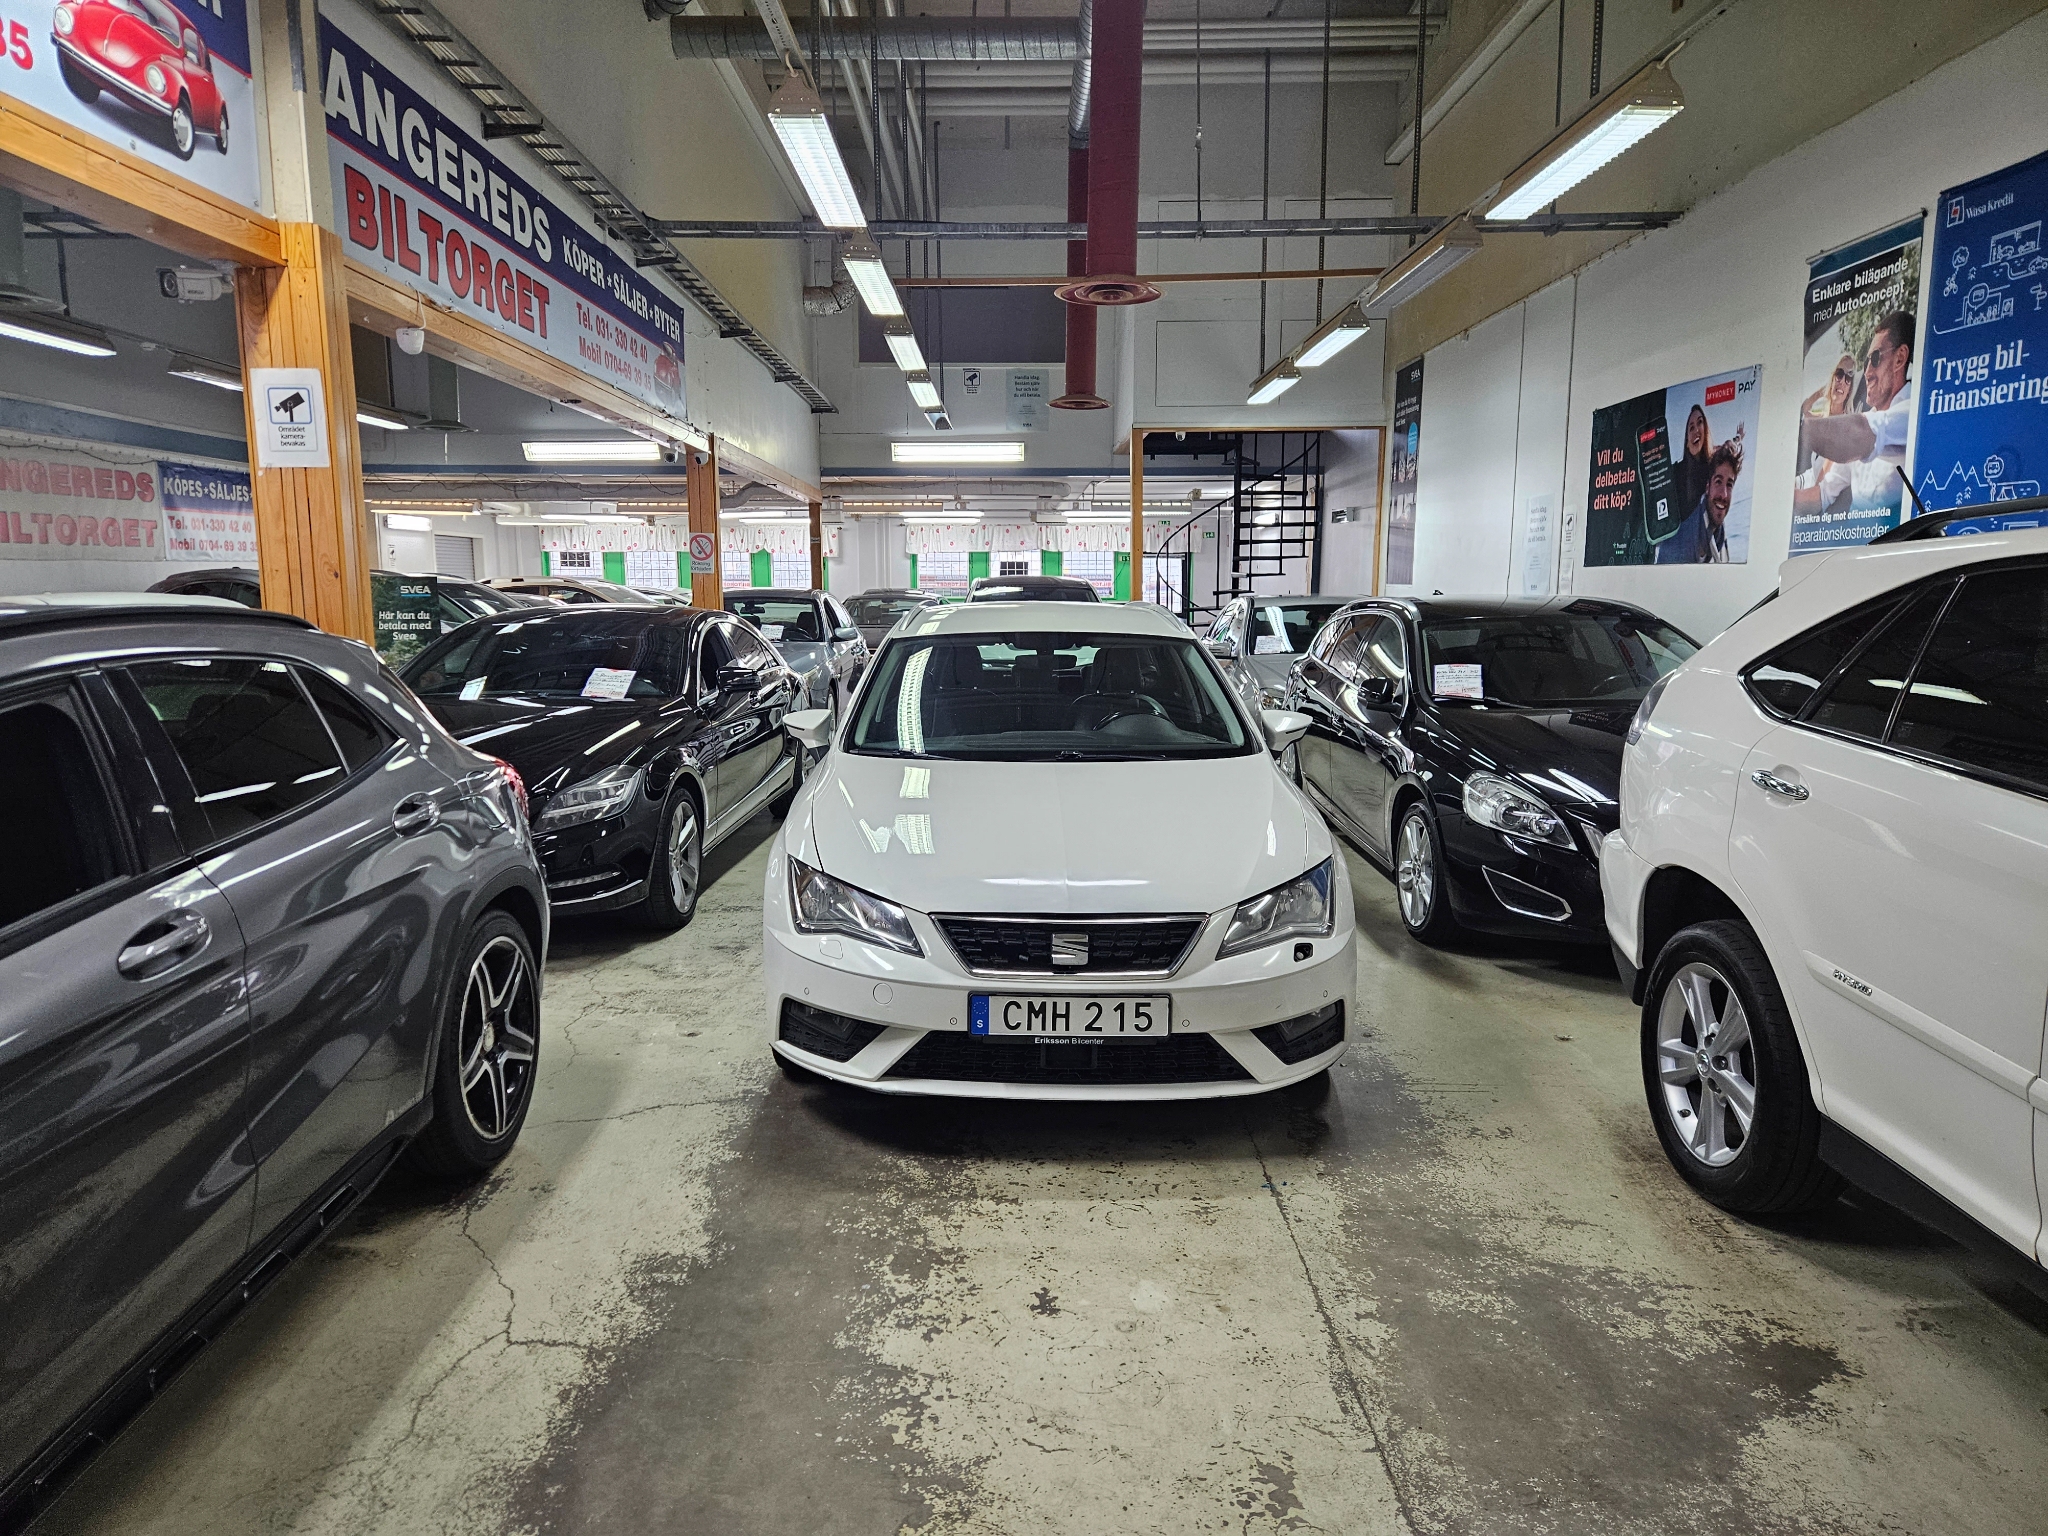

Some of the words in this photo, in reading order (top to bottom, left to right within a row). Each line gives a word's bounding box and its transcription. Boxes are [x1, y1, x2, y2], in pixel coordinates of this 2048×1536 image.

[325, 47, 551, 263] ANGEREDS
[1966, 205, 1987, 219] Wasa
[1987, 192, 2014, 211] Kredit
[344, 163, 550, 339] BILTORGET
[563, 235, 606, 290] KÖPER
[613, 272, 649, 321] SÄLJER
[654, 304, 681, 343] BYTER
[1812, 280, 1852, 304] Enklare
[1854, 257, 1909, 289] bilägande
[1813, 304, 1832, 324] med
[1834, 279, 1905, 316] AutoConcept
[576, 301, 593, 332] Tel.
[614, 326, 628, 352] 330
[629, 336, 638, 358] 42
[640, 344, 648, 364] 40
[578, 336, 601, 365] Mobil
[604, 354, 632, 382] 0704-69
[634, 368, 642, 386] 39
[1932, 352, 1991, 386] Trygg
[1995, 339, 2030, 372] bil-
[1706, 387, 1734, 401] MYMONEY
[1738, 379, 1756, 394] PAY
[1928, 374, 2048, 416] finansiering
[1597, 448, 1610, 467] Vill
[1611, 447, 1624, 462] du
[0, 457, 156, 503] NGEREDS
[164, 476, 203, 499] KÖPES
[208, 481, 250, 502] SÄLJES
[1595, 467, 1636, 489] delbetala
[1593, 493, 1609, 511] ditt
[1610, 490, 1633, 511] köp?
[167, 515, 188, 531] Tel.
[191, 517, 226, 533] 031-330
[228, 519, 240, 533] 42
[242, 520, 252, 534] 40
[1793, 515, 1820, 525] Försäkra
[1821, 512, 1832, 523] dig
[1833, 510, 1847, 521] mot
[1847, 507, 1891, 520] oförutsedda
[0, 511, 158, 548] ILTORGET
[1792, 523, 1890, 546] reparationskostnader
[169, 538, 195, 552] Mobil
[237, 540, 248, 553] 39
[400, 585, 432, 594] SVEA
[378, 611, 395, 620] Här
[397, 611, 416, 620] kan
[417, 611, 430, 620] du
[378, 621, 408, 630] betala
[409, 621, 432, 630] med
[392, 632, 417, 640] Svea
[976, 1019, 984, 1028] S
[1003, 1000, 1070, 1032] CMH
[1084, 1001, 1153, 1033] 215
[1034, 1037, 1070, 1045] Eriksson
[1071, 1037, 1104, 1045] Bilcenter
